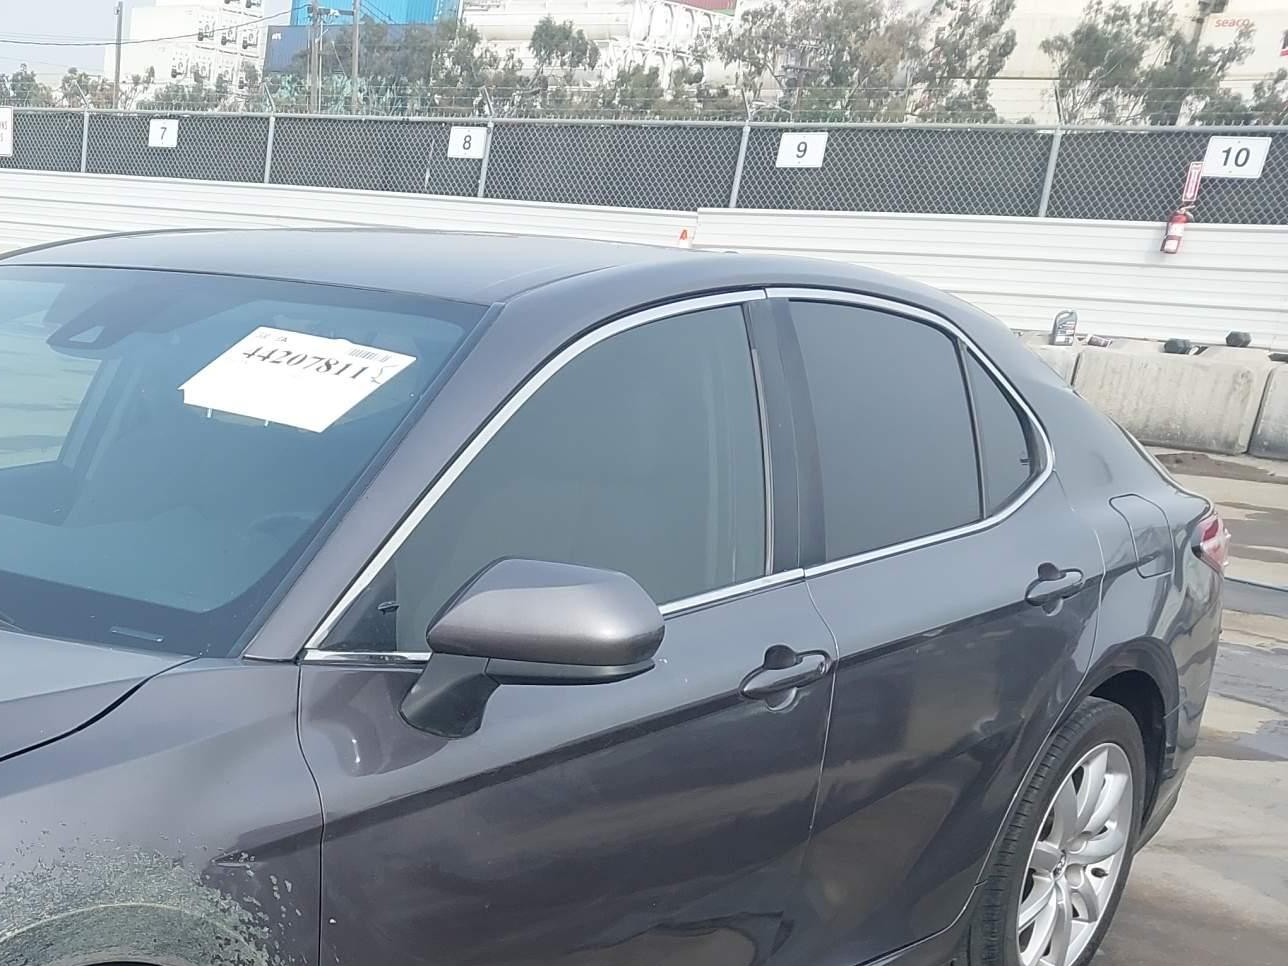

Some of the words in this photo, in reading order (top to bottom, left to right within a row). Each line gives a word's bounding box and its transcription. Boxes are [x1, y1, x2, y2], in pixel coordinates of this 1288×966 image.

[160, 126, 167, 141] 7
[462, 134, 472, 151] 8
[795, 140, 808, 159] 9
[1221, 146, 1251, 168] 10
[242, 346, 369, 380] 44207811
